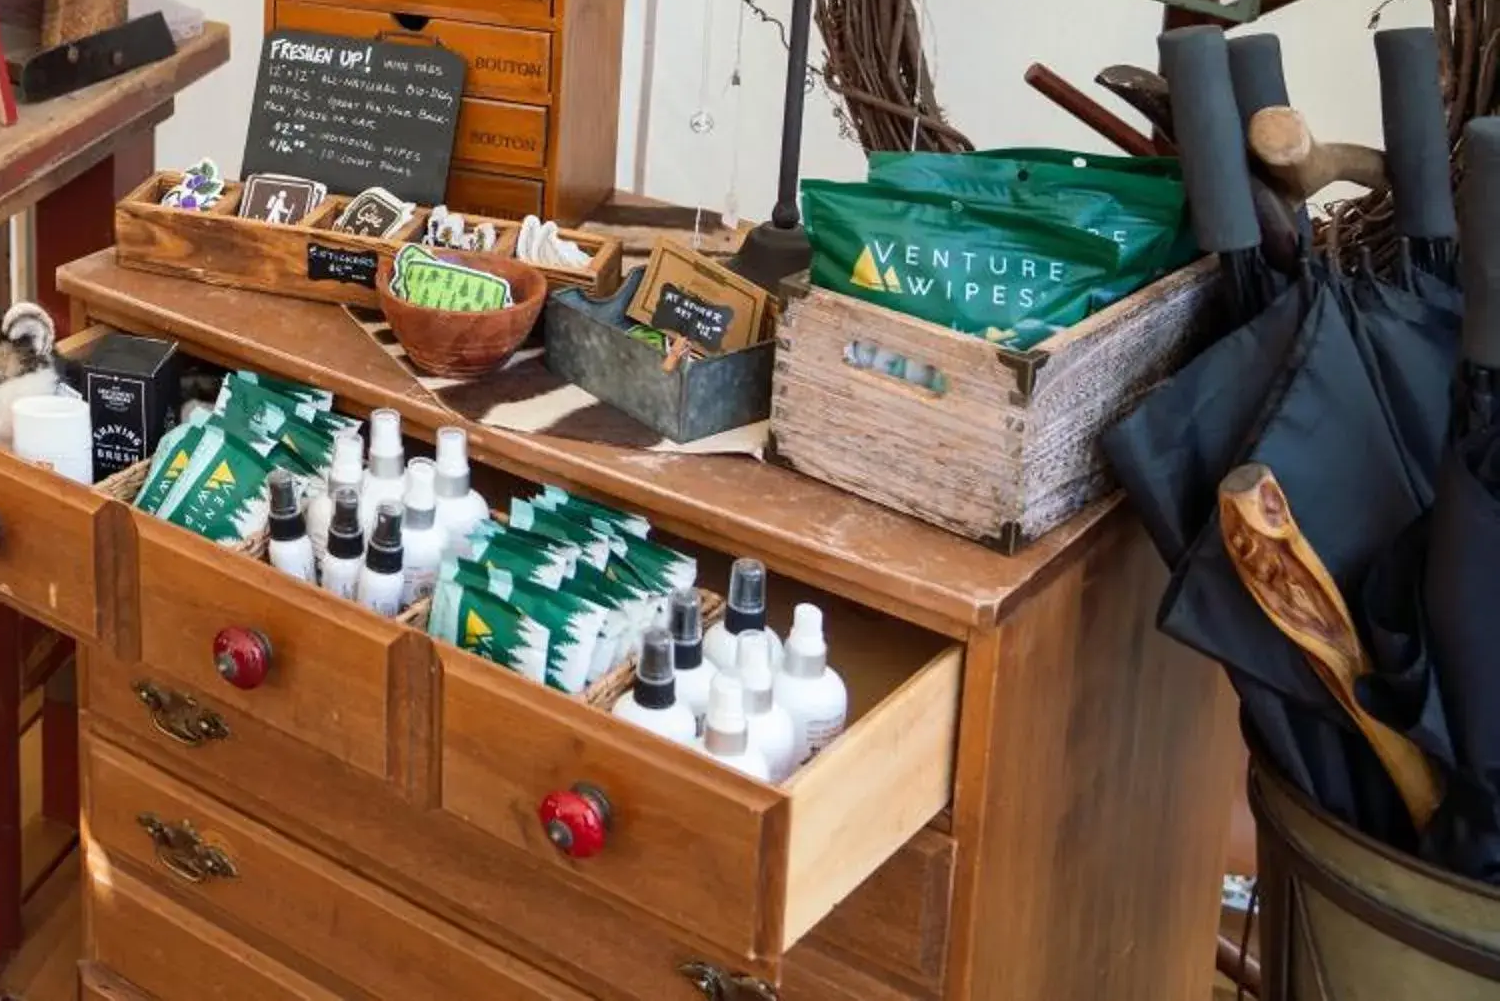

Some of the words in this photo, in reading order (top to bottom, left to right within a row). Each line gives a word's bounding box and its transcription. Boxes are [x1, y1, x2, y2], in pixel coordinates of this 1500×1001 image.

[270, 39, 333, 65] FRESHEN
[339, 46, 373, 74] UP!
[474, 57, 543, 77] BOUTON
[469, 130, 537, 151] BOUTON
[873, 240, 1066, 282] VENTURE
[907, 275, 1034, 308] WIPES
